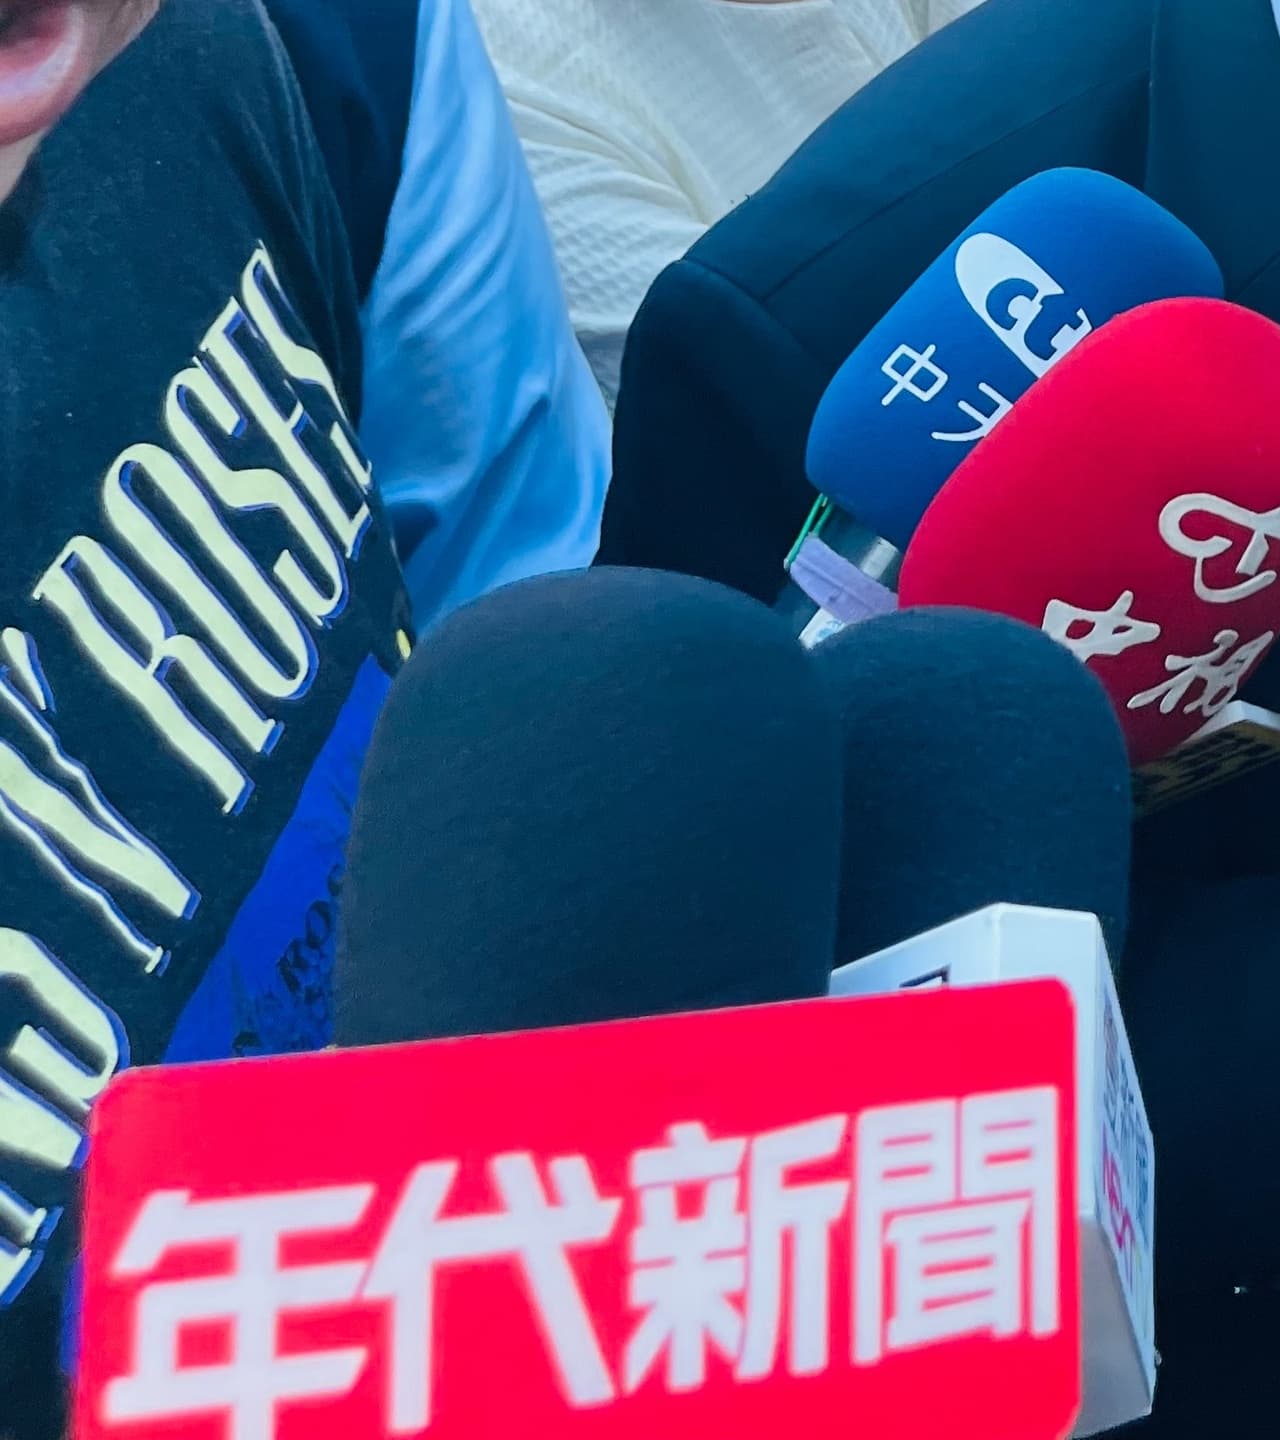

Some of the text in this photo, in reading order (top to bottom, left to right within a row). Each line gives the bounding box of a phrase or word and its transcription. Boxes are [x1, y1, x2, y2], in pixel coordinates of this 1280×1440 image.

[32, 240, 374, 814] ROSES
[98, 1085, 1062, 1440] 年代新聞
